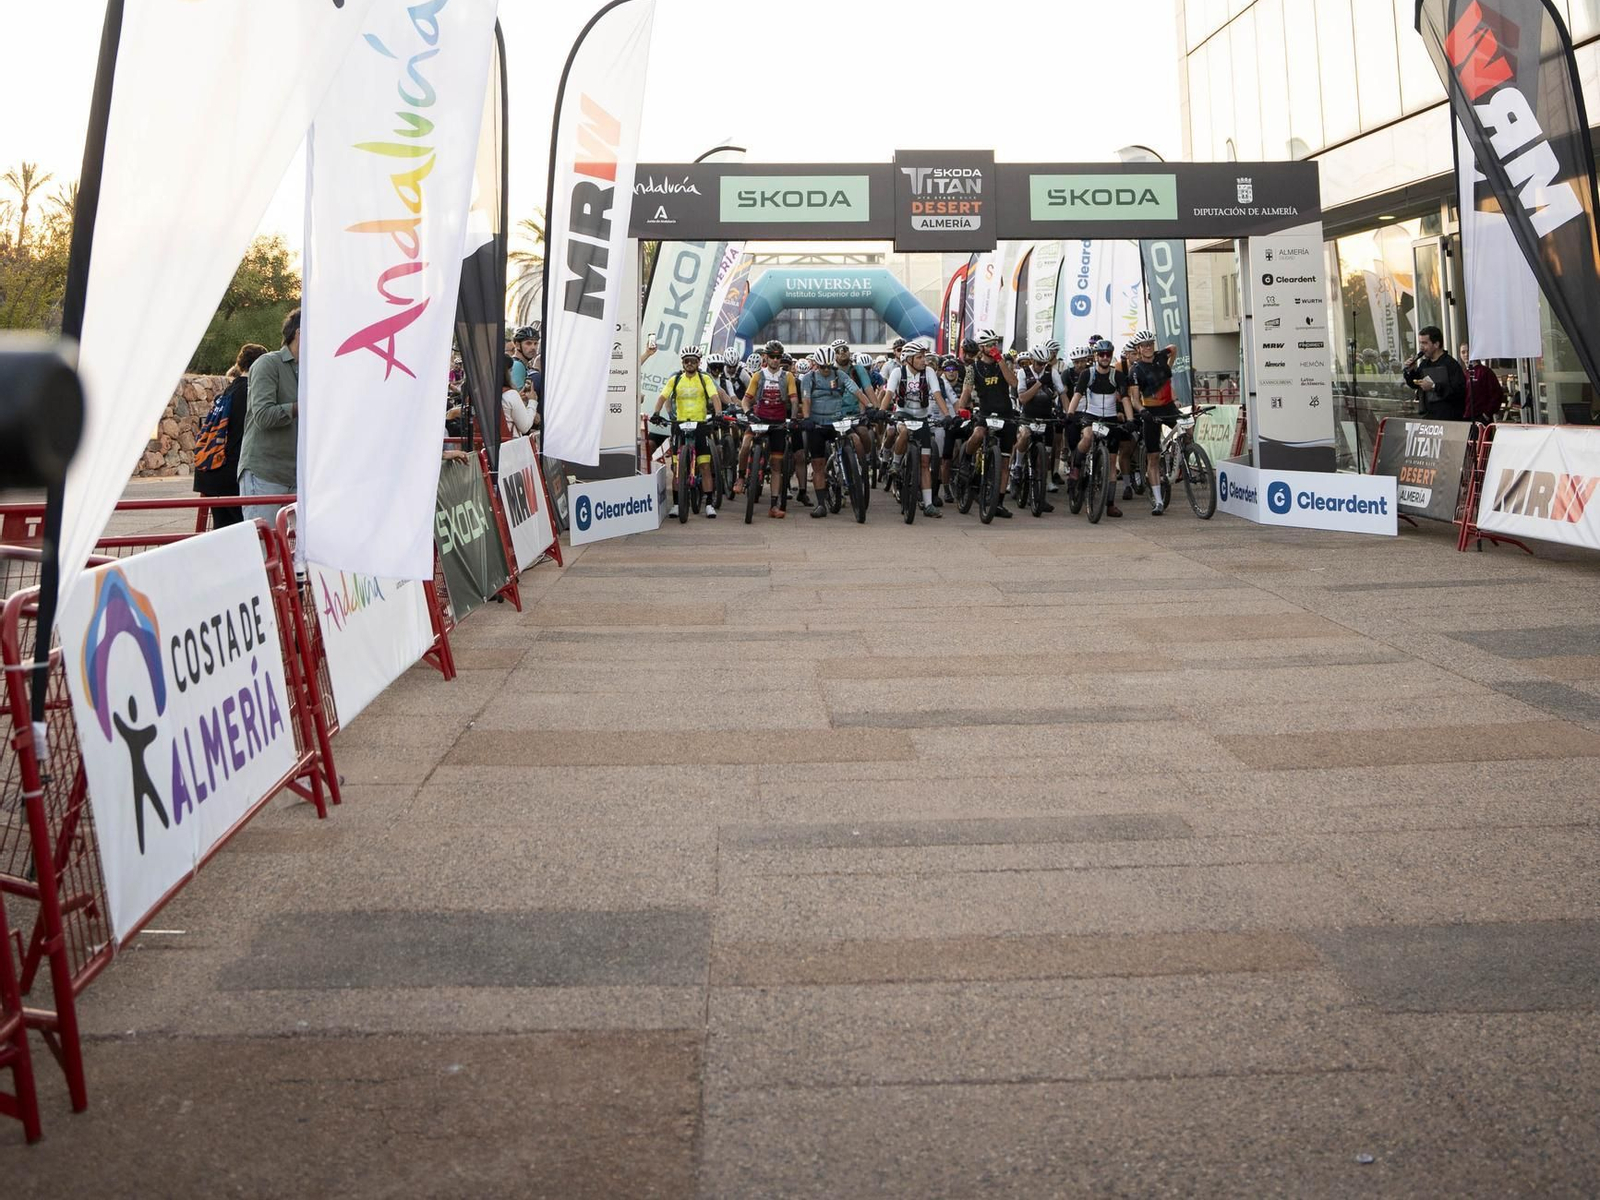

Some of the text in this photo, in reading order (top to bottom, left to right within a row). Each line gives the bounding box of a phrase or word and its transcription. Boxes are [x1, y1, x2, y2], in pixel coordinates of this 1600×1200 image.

[901, 167, 982, 195] TITAN
[933, 168, 982, 177] SKODA
[633, 176, 702, 195] ndalucía
[564, 92, 621, 320] MRW
[737, 190, 852, 208] SKODA
[911, 201, 982, 214] DESERT
[1047, 189, 1160, 206] SKODA
[920, 217, 971, 228] ALMERÍA
[1193, 206, 1298, 216] DIPUTACIÓN DE ALMERÍA
[1078, 240, 1092, 289] Cleard
[786, 278, 872, 290] UNIVERSAE
[1276, 275, 1317, 283] Cleardent
[656, 240, 706, 355] SKO
[1404, 422, 1442, 459] TITAN
[1400, 466, 1437, 485] DESERT
[503, 464, 539, 528] MRW
[1229, 481, 1257, 504] Cleardent
[1297, 491, 1388, 515] Cleardent
[1399, 489, 1425, 504] ALMERÍA
[1492, 468, 1600, 523] MRW
[595, 494, 653, 520] Cleardent
[171, 596, 266, 693] COSTA DE
[172, 655, 284, 825] ALMERÍA
